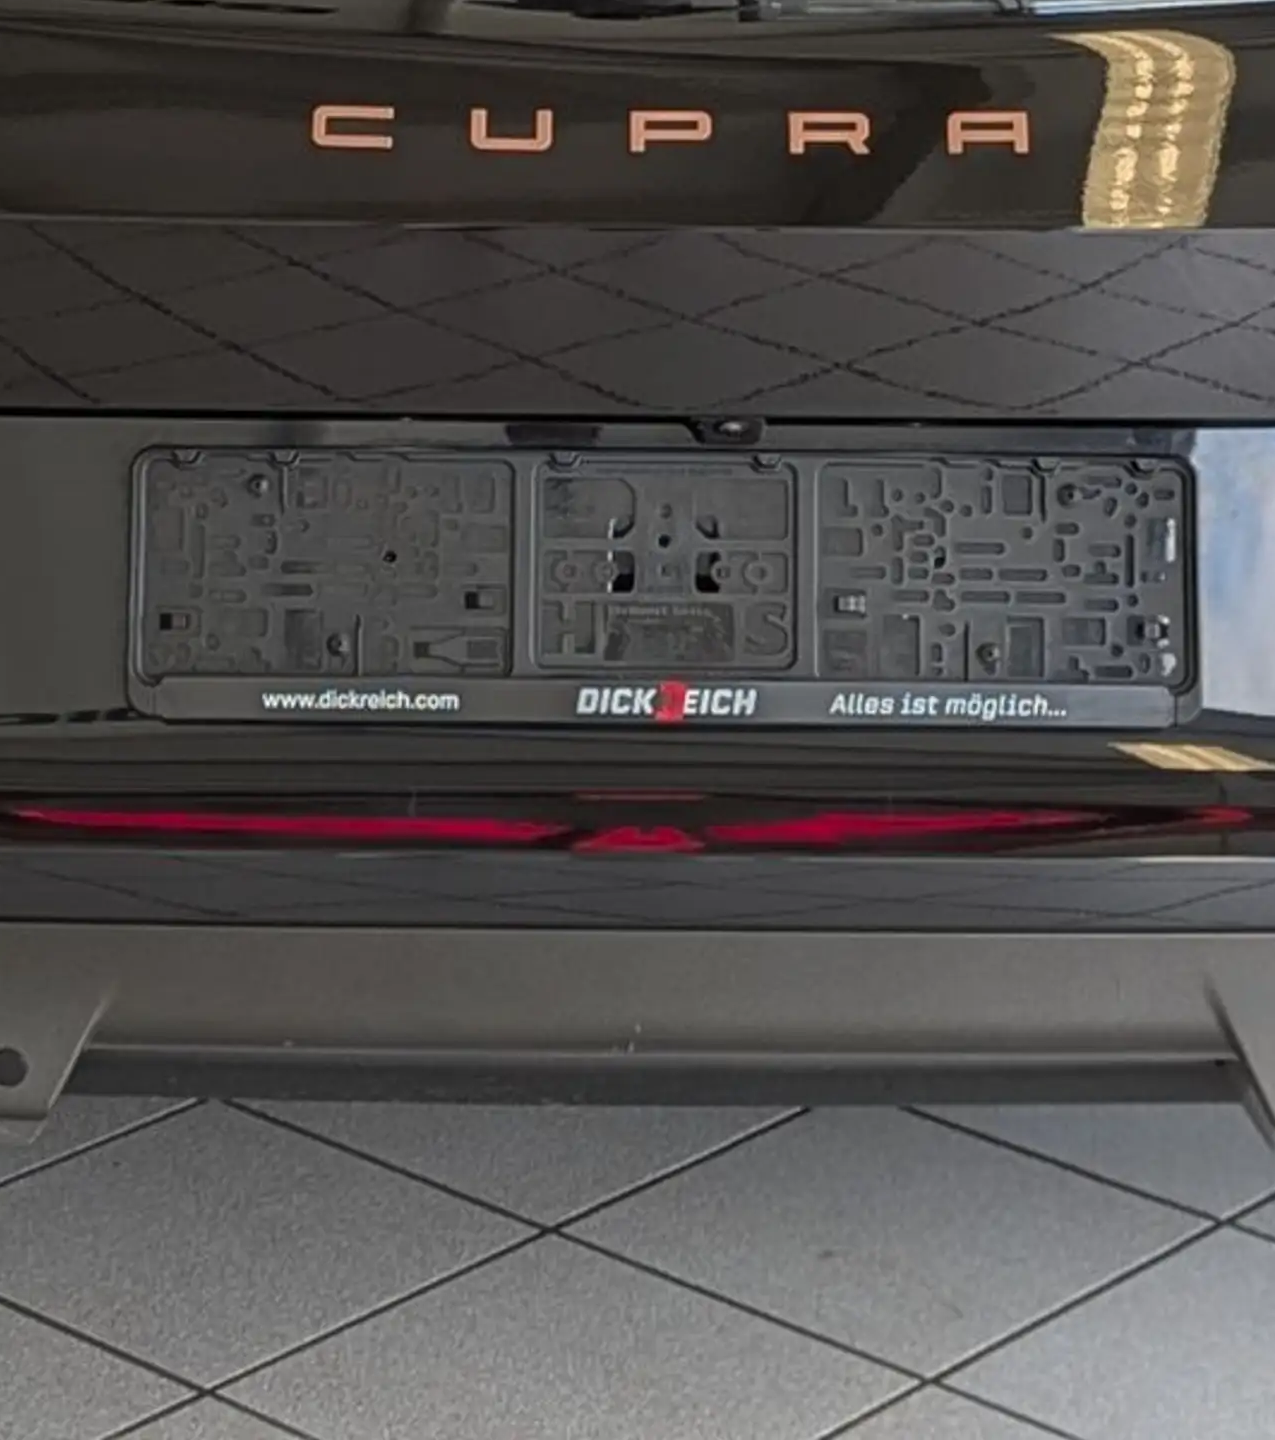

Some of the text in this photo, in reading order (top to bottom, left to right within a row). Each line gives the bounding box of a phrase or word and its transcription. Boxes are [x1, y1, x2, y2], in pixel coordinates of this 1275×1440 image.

[311, 105, 1030, 155] CUPRA
[262, 690, 460, 710] www.dickreich.com
[829, 692, 1067, 722] Alles ist möglich...
